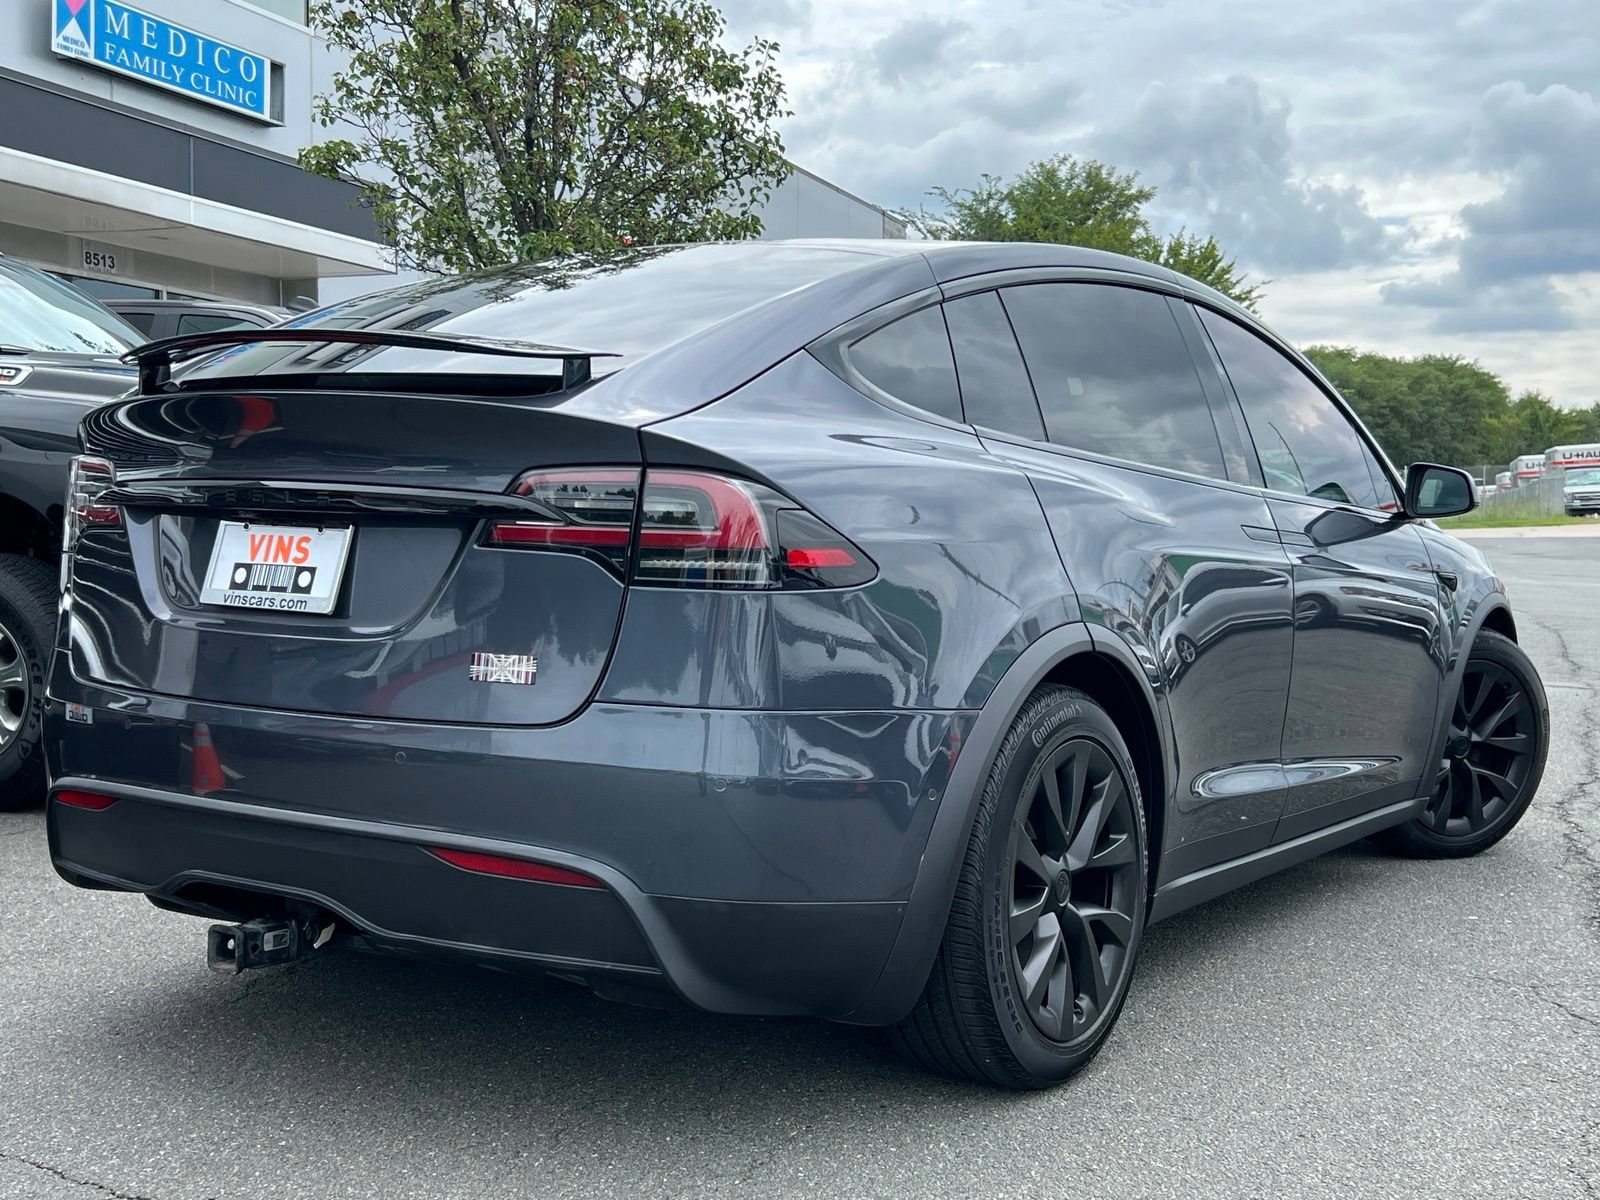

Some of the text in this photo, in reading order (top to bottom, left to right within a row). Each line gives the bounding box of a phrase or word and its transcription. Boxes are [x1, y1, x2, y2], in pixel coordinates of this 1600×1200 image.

[104, 4, 257, 82] MEDICO
[104, 42, 257, 108] FAMILY CLINIC
[84, 251, 115, 269] 8513
[1525, 462, 1545, 470] U-H
[1562, 451, 1600, 460] U-HAU
[249, 533, 312, 565] VINS
[223, 591, 308, 611] vinscars.com
[1031, 703, 1077, 748] Continental
